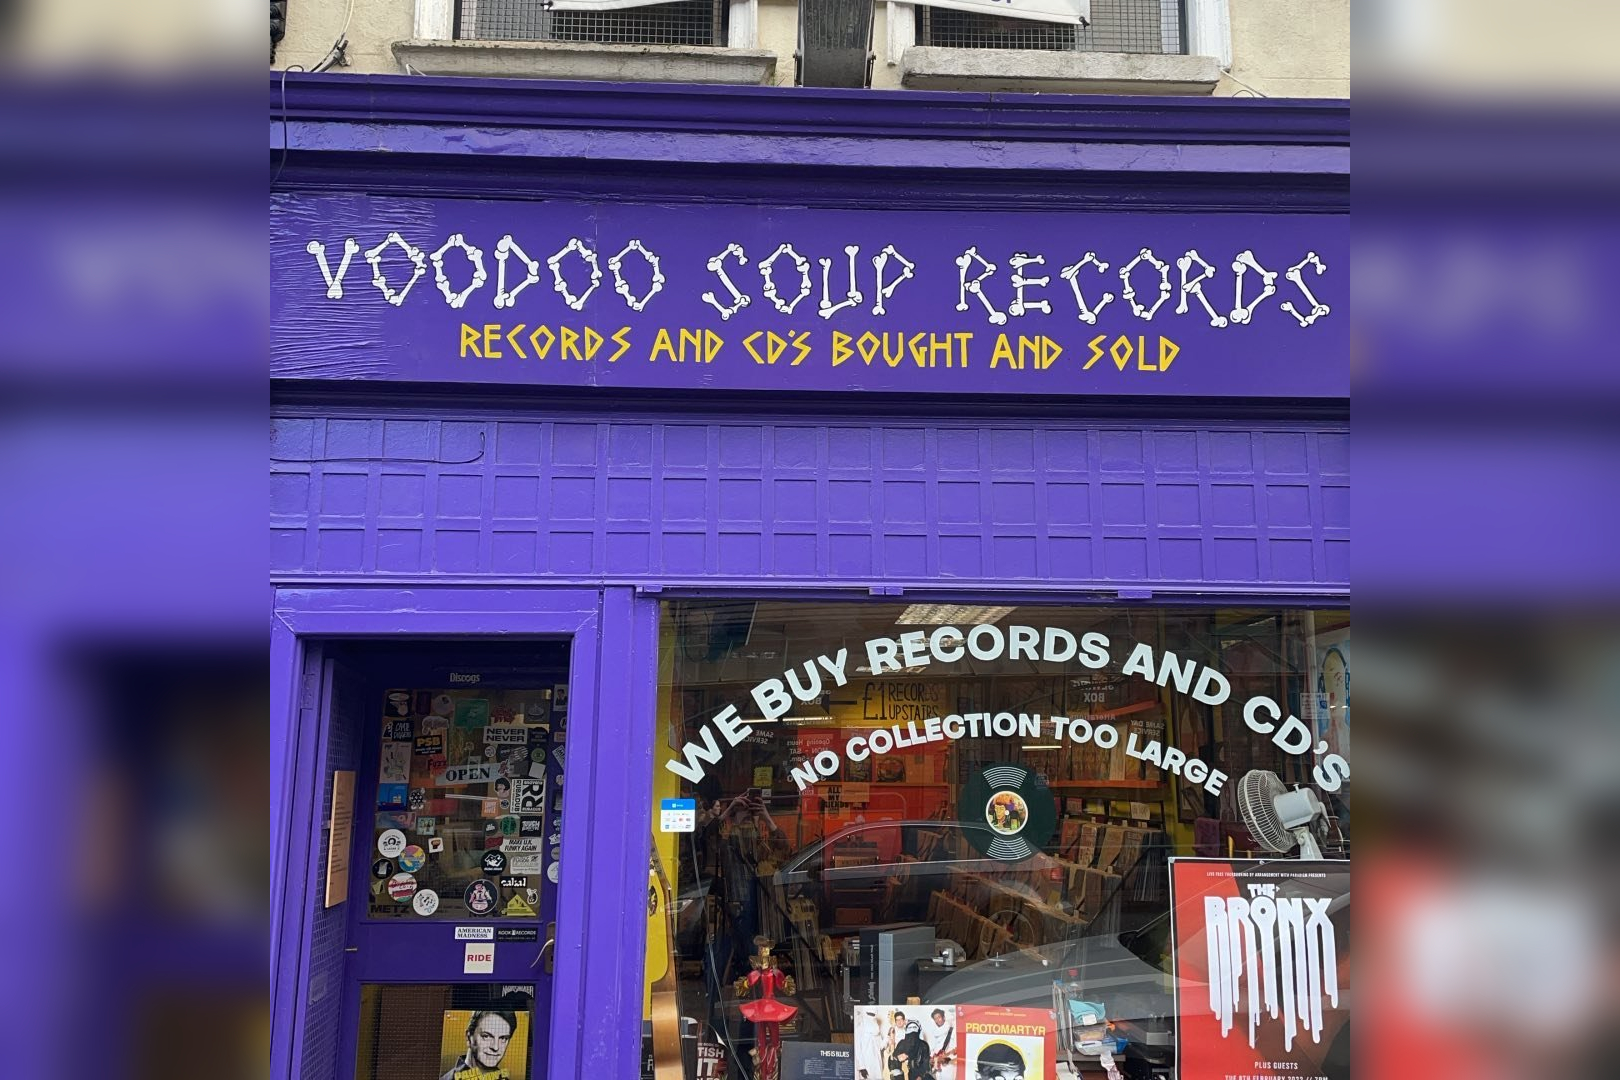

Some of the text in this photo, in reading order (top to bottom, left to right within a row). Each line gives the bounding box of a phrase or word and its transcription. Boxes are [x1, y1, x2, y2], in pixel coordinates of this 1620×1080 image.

[306, 232, 1330, 328] VOODOO SOUP RECORDS
[459, 324, 1180, 371] RECORDS AND CD'S BOUGHT AND SOLD
[449, 672, 480, 684] Discogs
[665, 624, 1350, 792] WE BUY RECORDS AND CD'S
[862, 682, 887, 720] £1
[889, 704, 939, 721] UPSTAIRS
[486, 728, 525, 736] NEVER
[790, 713, 1228, 797] NO COLLECTION TOO LARGE
[445, 767, 491, 781] OPEN
[1247, 883, 1279, 900] THE
[370, 904, 410, 914] METZ
[467, 954, 492, 962] RIDE
[1204, 895, 1338, 1052] BRONX
[966, 1022, 1045, 1036] PROTOMARTYR
[1255, 1061, 1298, 1070] PLUS GUESTS
